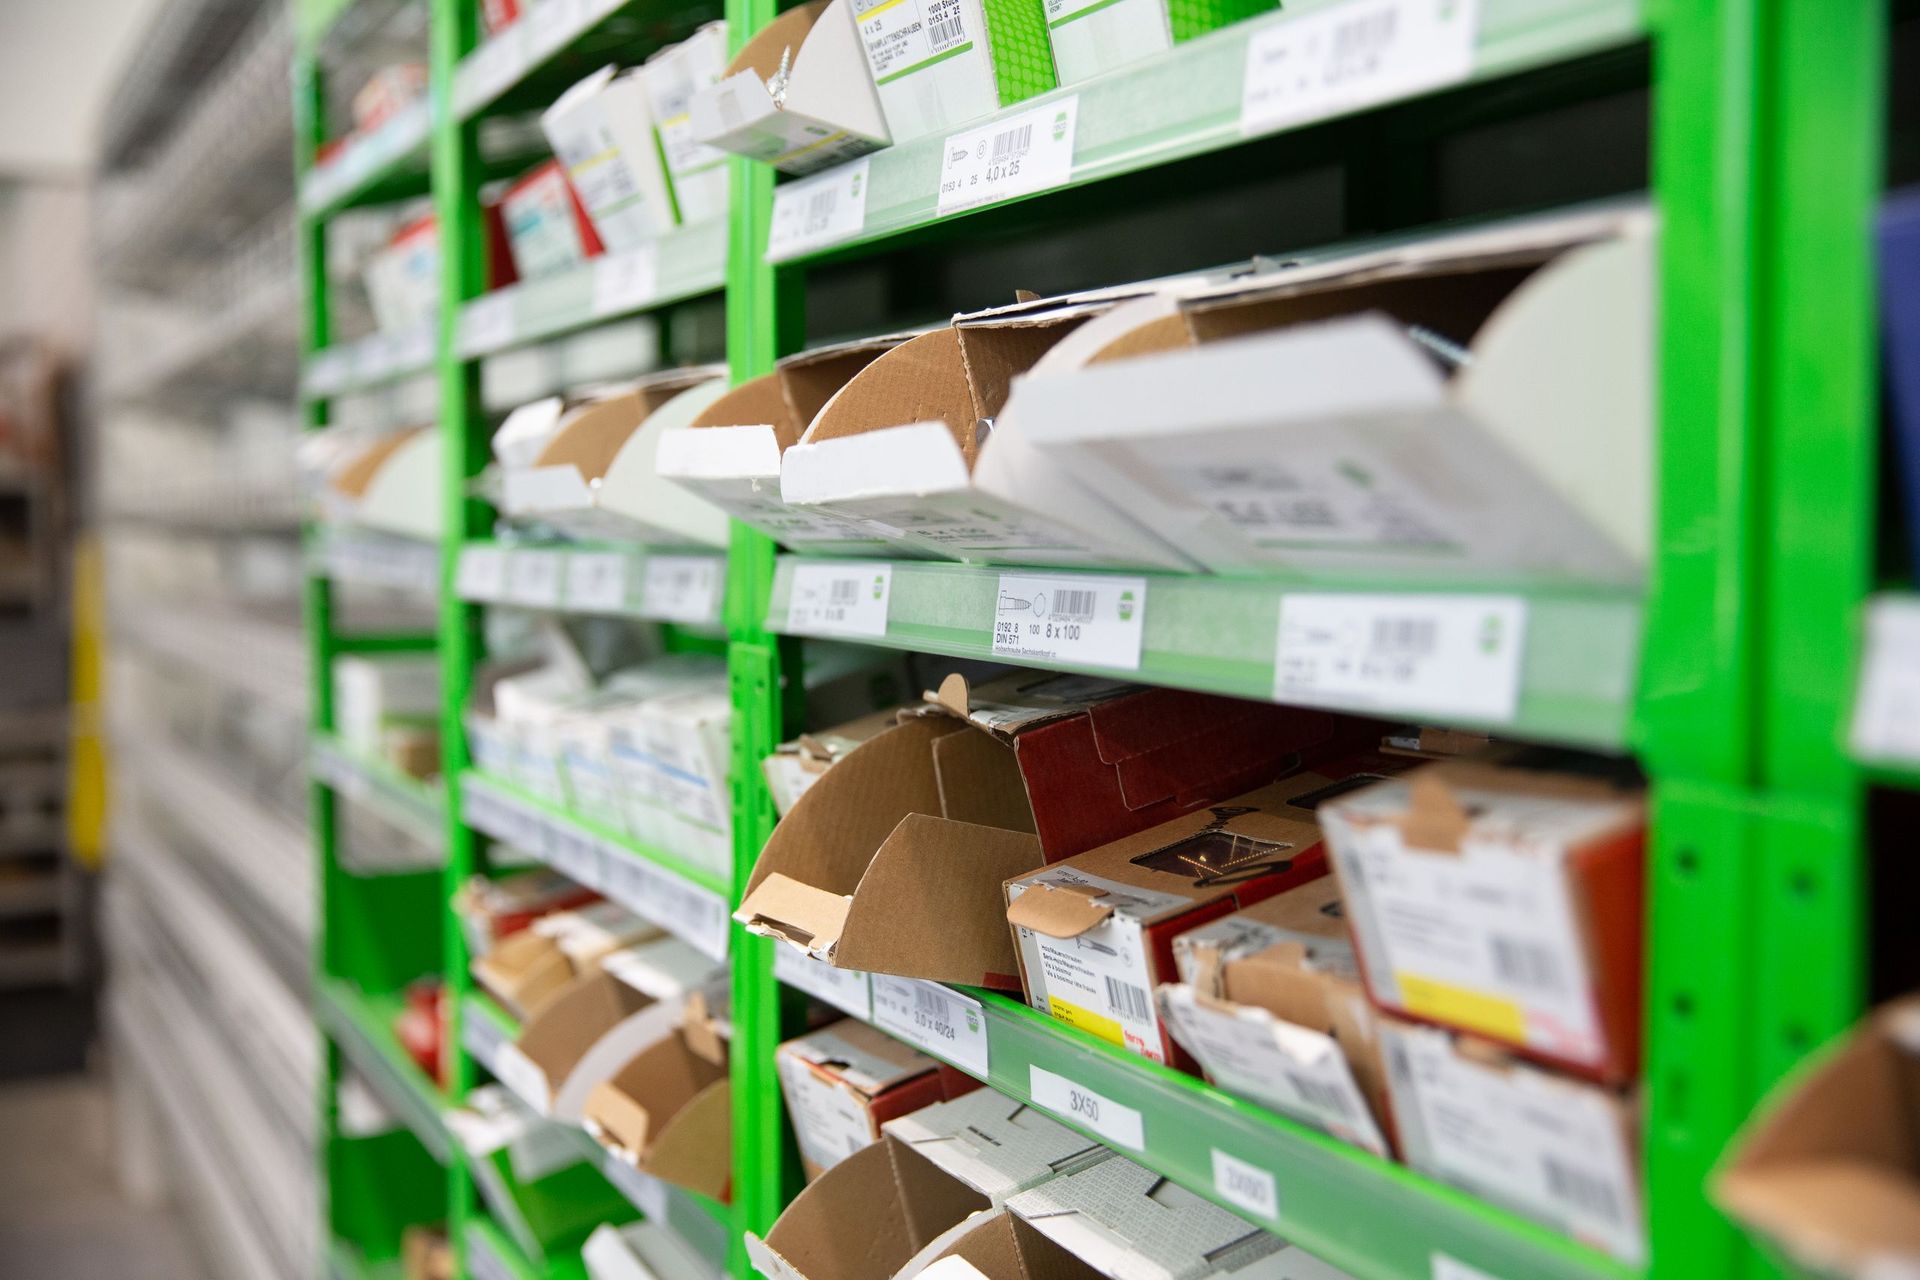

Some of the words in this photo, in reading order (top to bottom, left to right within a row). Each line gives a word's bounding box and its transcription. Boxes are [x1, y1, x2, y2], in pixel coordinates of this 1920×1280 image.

[928, 2, 942, 15] 1000
[928, 13, 943, 26] 0153
[943, 10, 949, 18] 4
[953, 5, 960, 15] 25
[874, 19, 883, 32] 25
[986, 166, 1000, 184] 4,0
[1001, 167, 1007, 178] x
[1009, 160, 1020, 176] 25
[942, 181, 956, 194] 0153
[957, 179, 962, 188] 4
[970, 174, 978, 185] 25
[996, 633, 1007, 645] DIN
[1008, 634, 1019, 646] 571
[997, 621, 1012, 633] 0192
[1014, 623, 1019, 633] 8
[1029, 624, 1040, 635] 100
[1046, 623, 1052, 639] 8
[1054, 627, 1060, 639] x
[1063, 624, 1080, 640] 100
[928, 1019, 933, 1031] x
[934, 1020, 955, 1041] 40/24
[1070, 1090, 1099, 1122] 3X50
